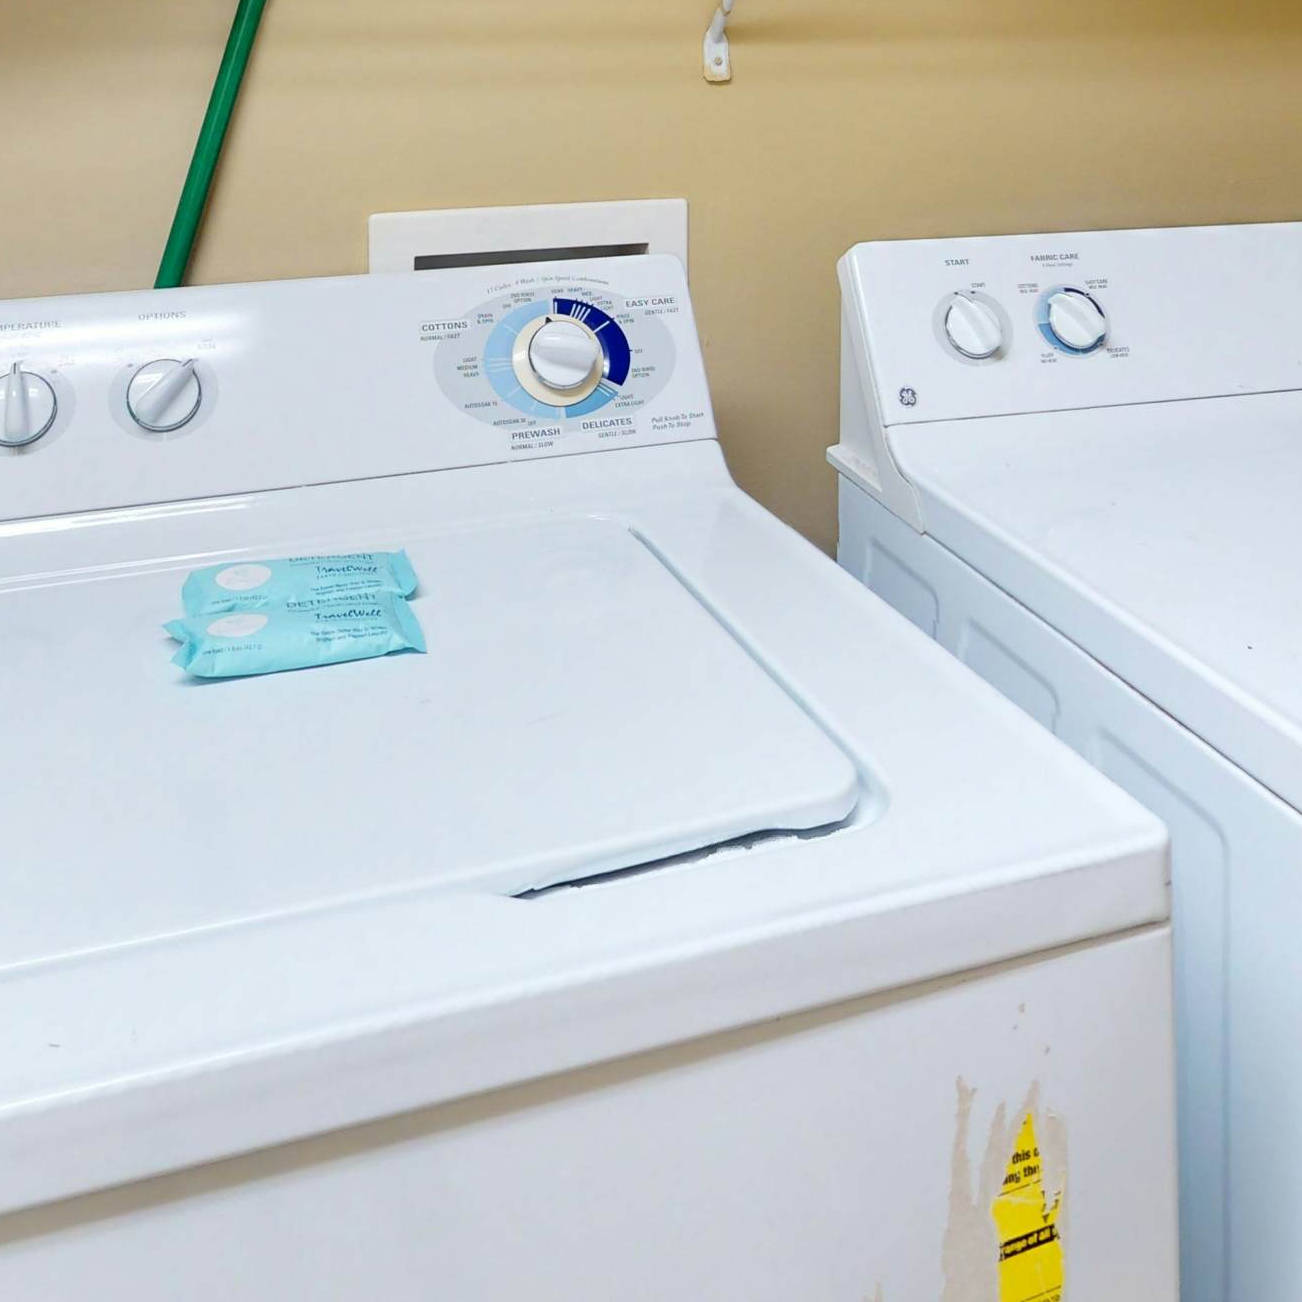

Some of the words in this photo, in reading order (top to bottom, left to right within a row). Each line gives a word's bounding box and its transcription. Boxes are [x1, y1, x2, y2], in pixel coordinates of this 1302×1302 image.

[944, 258, 970, 267] START
[1059, 252, 1080, 261] CARE
[625, 299, 650, 308] EASY
[651, 297, 675, 306] CARE
[138, 310, 187, 322] OPTIONS
[421, 320, 469, 332] COTTONS
[581, 417, 633, 431] DELICATES
[511, 427, 561, 441] PREWASH
[1011, 1149, 1031, 1165] this
